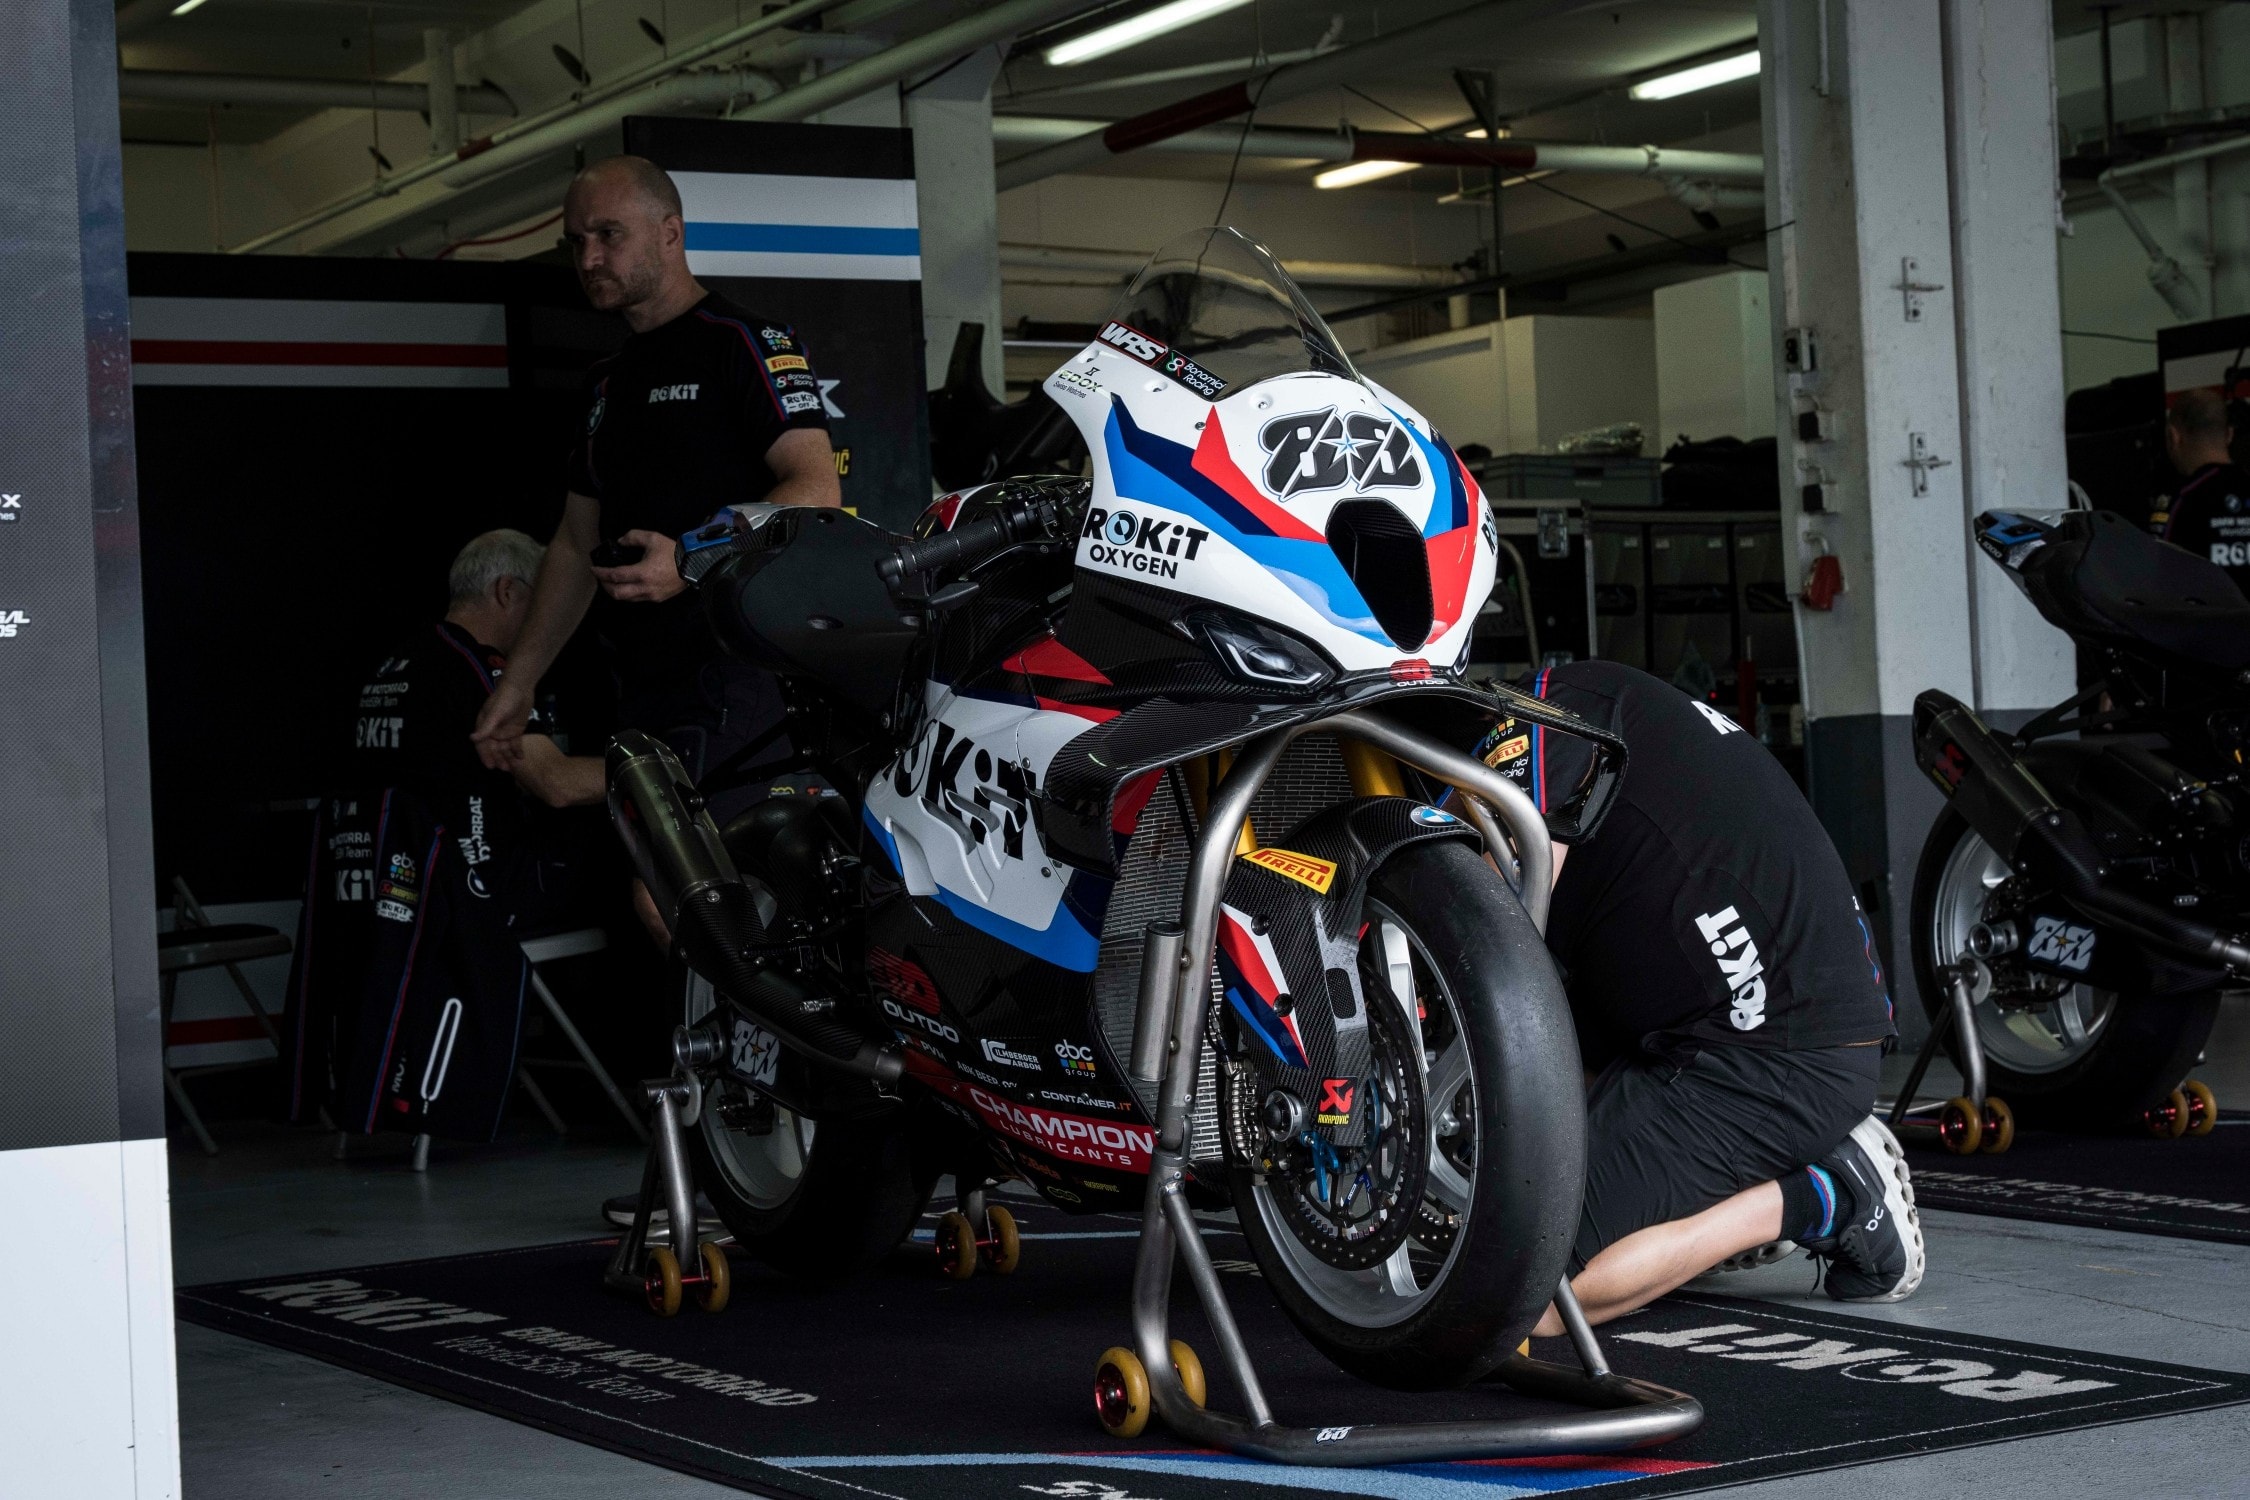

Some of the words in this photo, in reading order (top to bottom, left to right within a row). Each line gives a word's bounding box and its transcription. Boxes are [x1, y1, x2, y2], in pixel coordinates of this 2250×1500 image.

[1100, 322, 1167, 361] WRS
[1058, 369, 1103, 392] EDOX
[1182, 374, 1215, 396] Racing
[1183, 362, 1227, 391] Bonamici
[1082, 507, 1209, 561] ROKiT
[1090, 544, 1178, 580] OXYGEN
[355, 716, 405, 749] OKiT
[1487, 740, 1524, 766] RELLI
[883, 718, 1037, 861] OKiT
[1253, 850, 1331, 886] PIRELLI
[882, 999, 960, 1044] OUTDO
[1054, 1039, 1094, 1061] ebc
[1065, 1068, 1096, 1079] group
[970, 1088, 1156, 1154] CHAMPION
[1000, 1122, 1132, 1166] LUBRICANTS
[498, 1326, 617, 1352] BMW
[582, 1349, 819, 1406] MOTORRAD
[577, 1373, 677, 1403] Team
